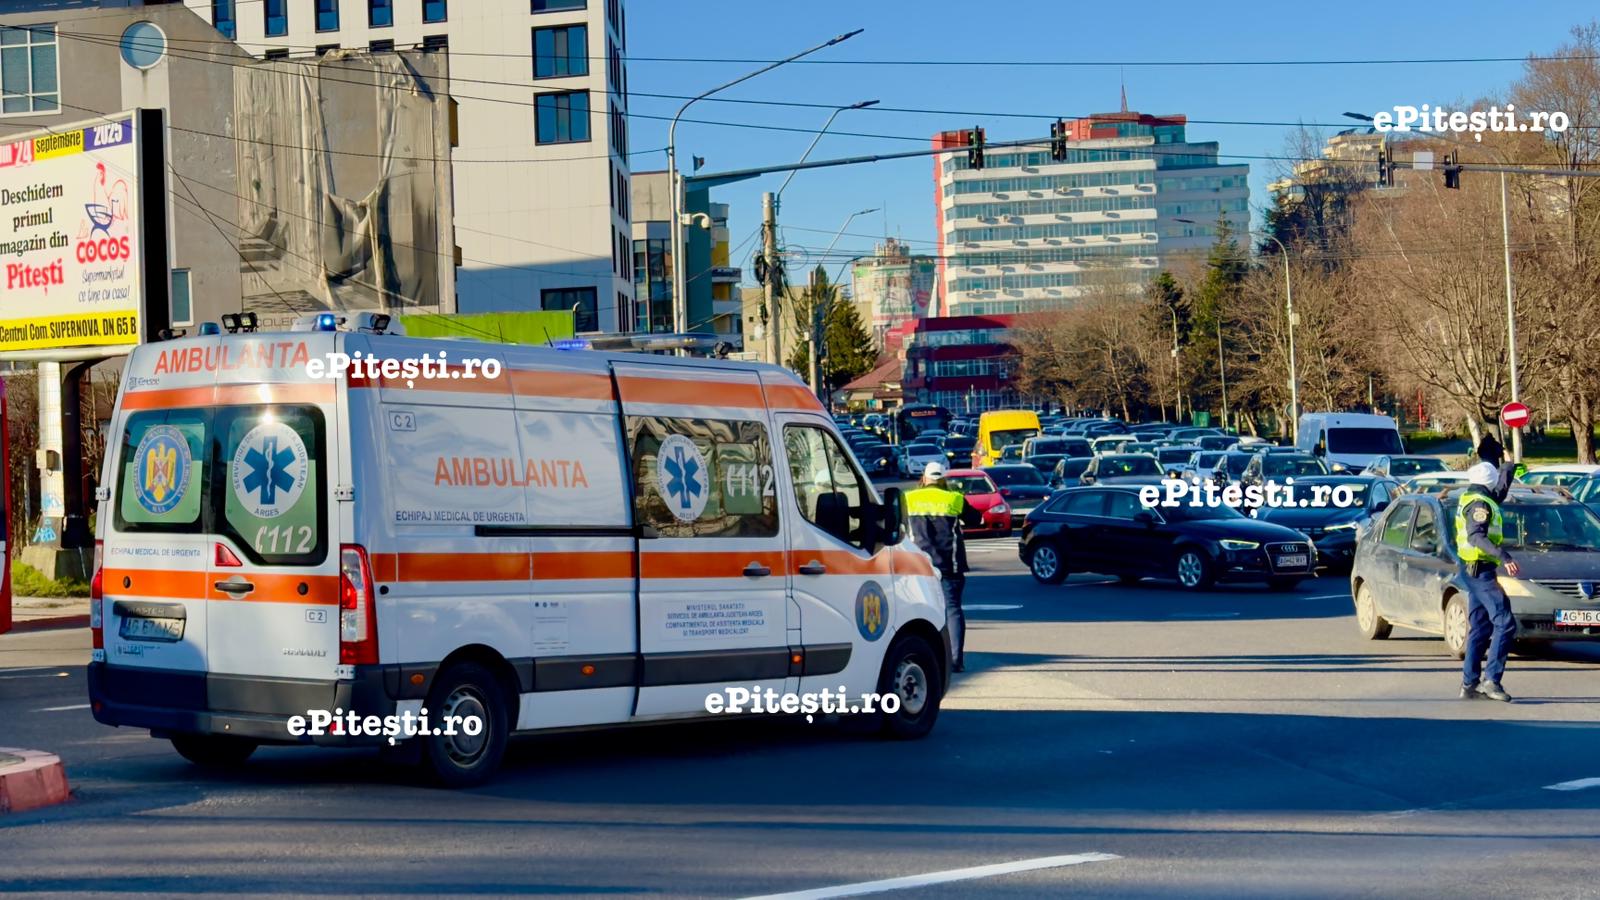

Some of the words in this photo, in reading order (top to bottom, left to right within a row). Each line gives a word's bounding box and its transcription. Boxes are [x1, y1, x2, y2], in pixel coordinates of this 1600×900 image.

[36, 131, 81, 153] septembrie
[93, 122, 123, 146] 2025
[1, 182, 63, 206] Deschidem
[12, 207, 53, 232] primul
[0, 234, 46, 257] magazin
[49, 230, 69, 249] din
[6, 258, 64, 295] Pitești
[0, 324, 28, 343] Centrul
[103, 317, 115, 336] DN
[117, 316, 129, 335] 65
[130, 316, 137, 335] B
[154, 341, 310, 374] AMBULANTA
[394, 414, 402, 428] C
[405, 415, 411, 428] 2
[434, 456, 589, 488] AMBULANTA
[736, 463, 775, 496] 112
[254, 507, 280, 517] ARGES
[395, 511, 432, 521] ECHIPAJ
[434, 511, 471, 522] MEDICAL
[473, 512, 485, 522] DE
[486, 512, 525, 522] URGENTA
[268, 524, 312, 553] 112
[135, 547, 160, 556] MEDICAL
[161, 548, 170, 556] DE
[171, 548, 201, 557] URGENTA
[309, 611, 315, 620] C
[317, 612, 323, 621] 2
[1563, 611, 1578, 622] AG
[1582, 612, 1592, 622] 16
